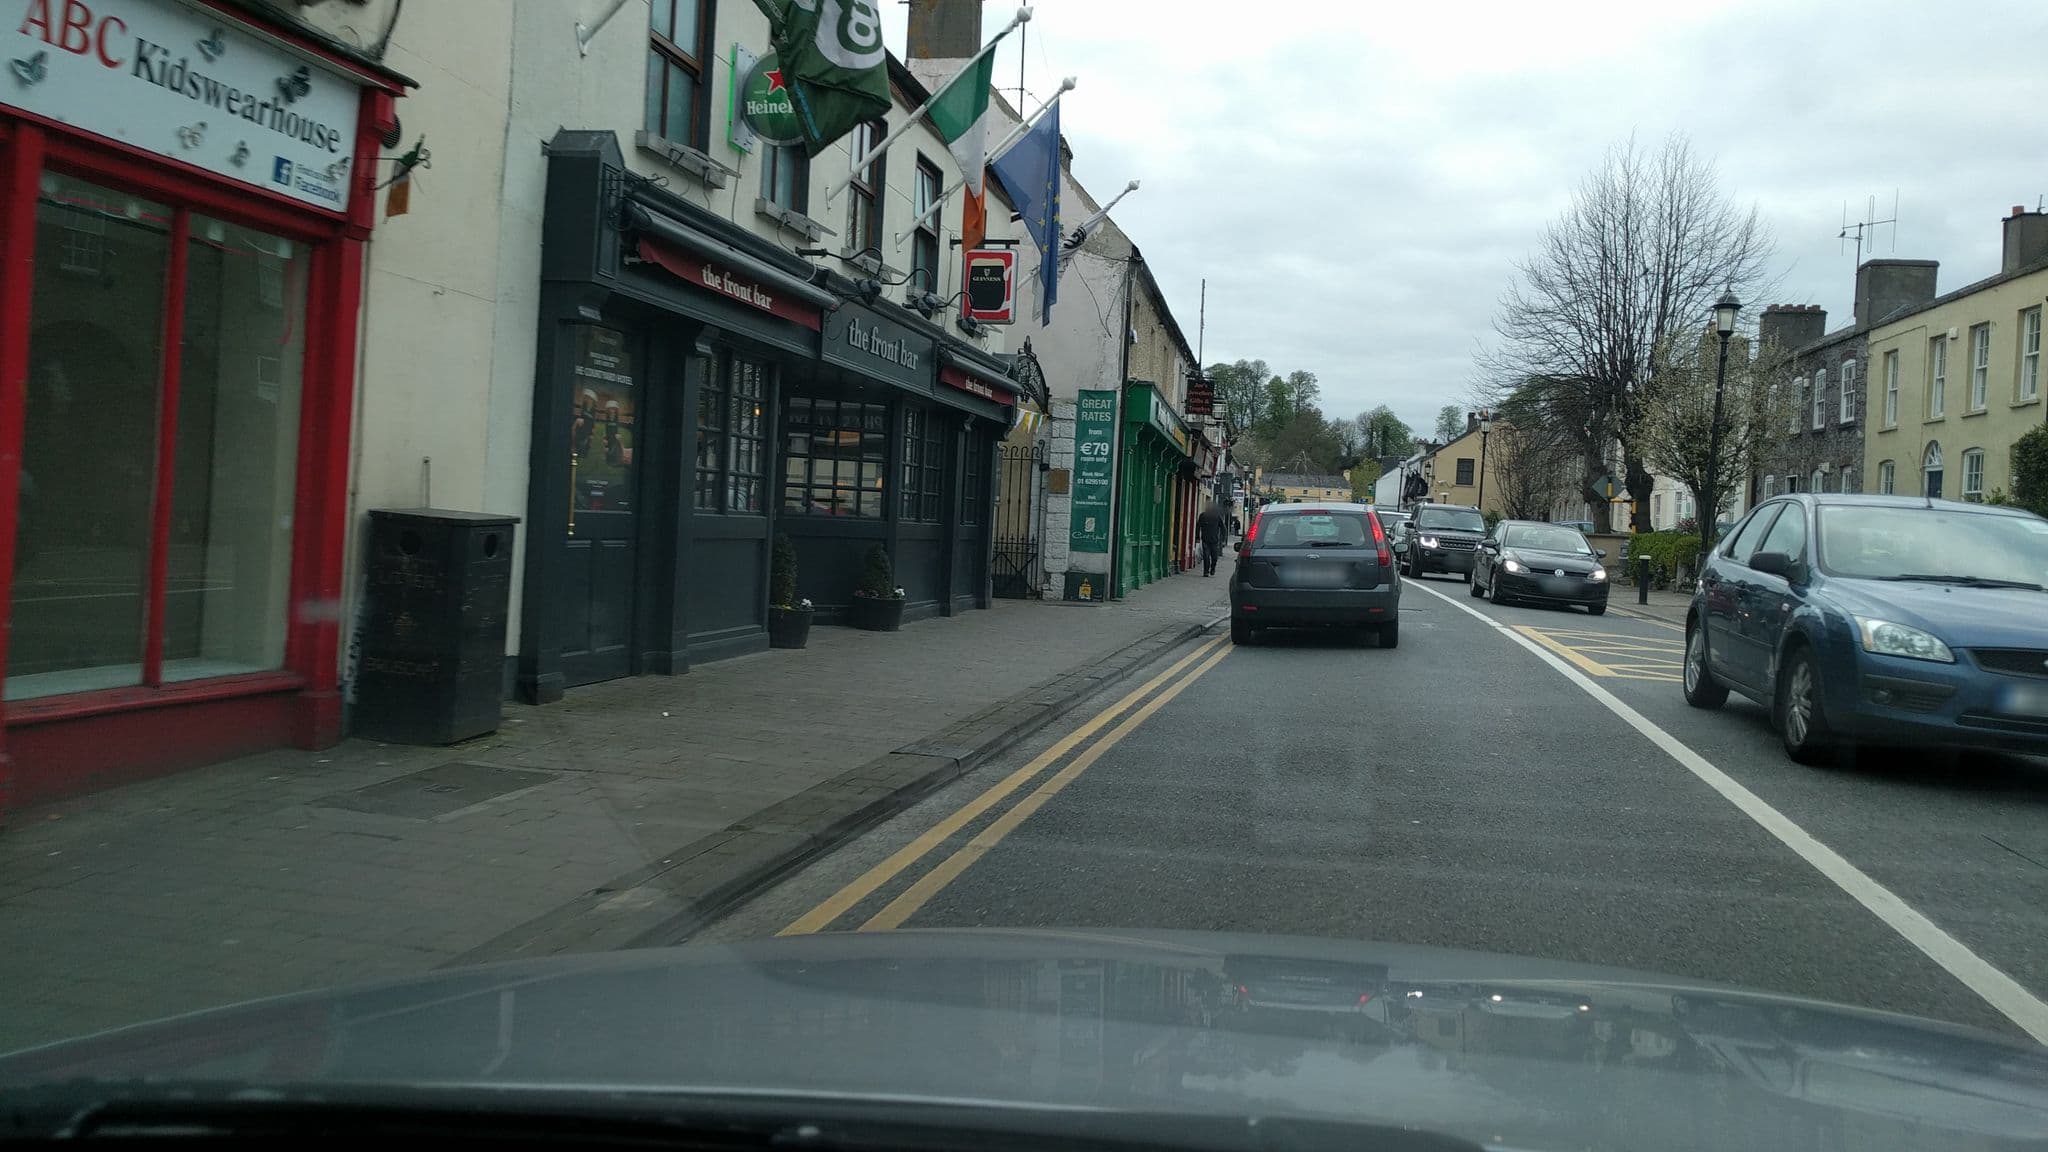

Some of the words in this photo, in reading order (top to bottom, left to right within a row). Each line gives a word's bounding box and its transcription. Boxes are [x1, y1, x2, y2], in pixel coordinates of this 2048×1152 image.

[17, 0, 128, 68] ABC
[130, 37, 343, 154] Kidswearhouse
[702, 264, 722, 290] the
[722, 271, 753, 302] front
[753, 284, 773, 310] bar
[849, 318, 870, 351] the
[870, 326, 899, 363] front
[900, 339, 919, 370] bar
[1081, 398, 1112, 409] GREAT
[1081, 411, 1112, 422] RATES
[1088, 428, 1103, 436] from
[1080, 442, 1109, 456] €79
